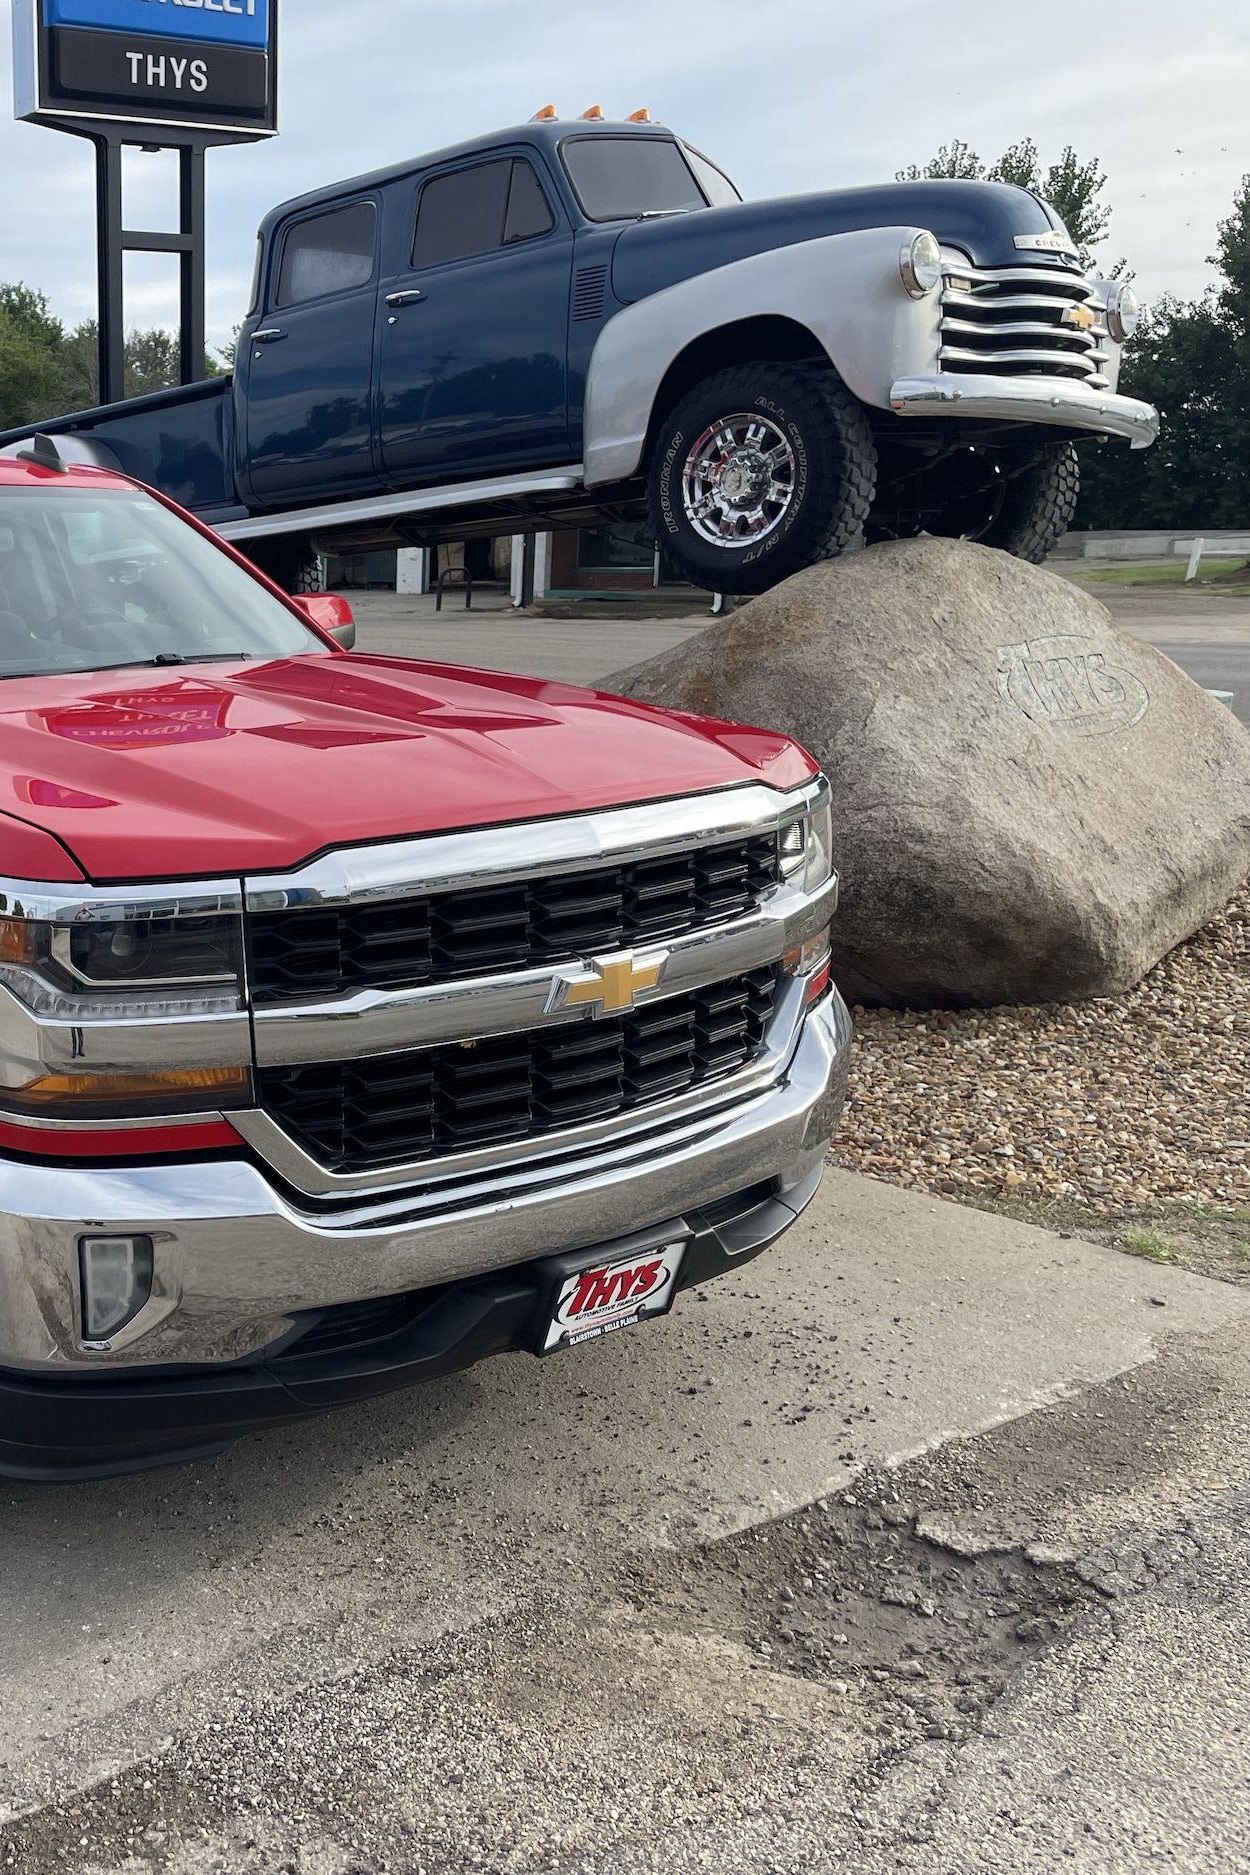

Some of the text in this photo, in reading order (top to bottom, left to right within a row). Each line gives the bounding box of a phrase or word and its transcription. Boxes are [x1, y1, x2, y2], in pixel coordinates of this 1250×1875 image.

[125, 51, 209, 93] THYS
[659, 430, 685, 534] IRONMAN
[754, 395, 786, 422] ALL
[785, 422, 808, 532] COUNTRY
[996, 643, 1126, 715] THYS
[566, 1259, 664, 1317] THYS
[574, 1296, 640, 1321] AUTOMOTIVE FAMILY
[569, 1314, 639, 1346] BLAIRSTOWN BELLE PLAINE
